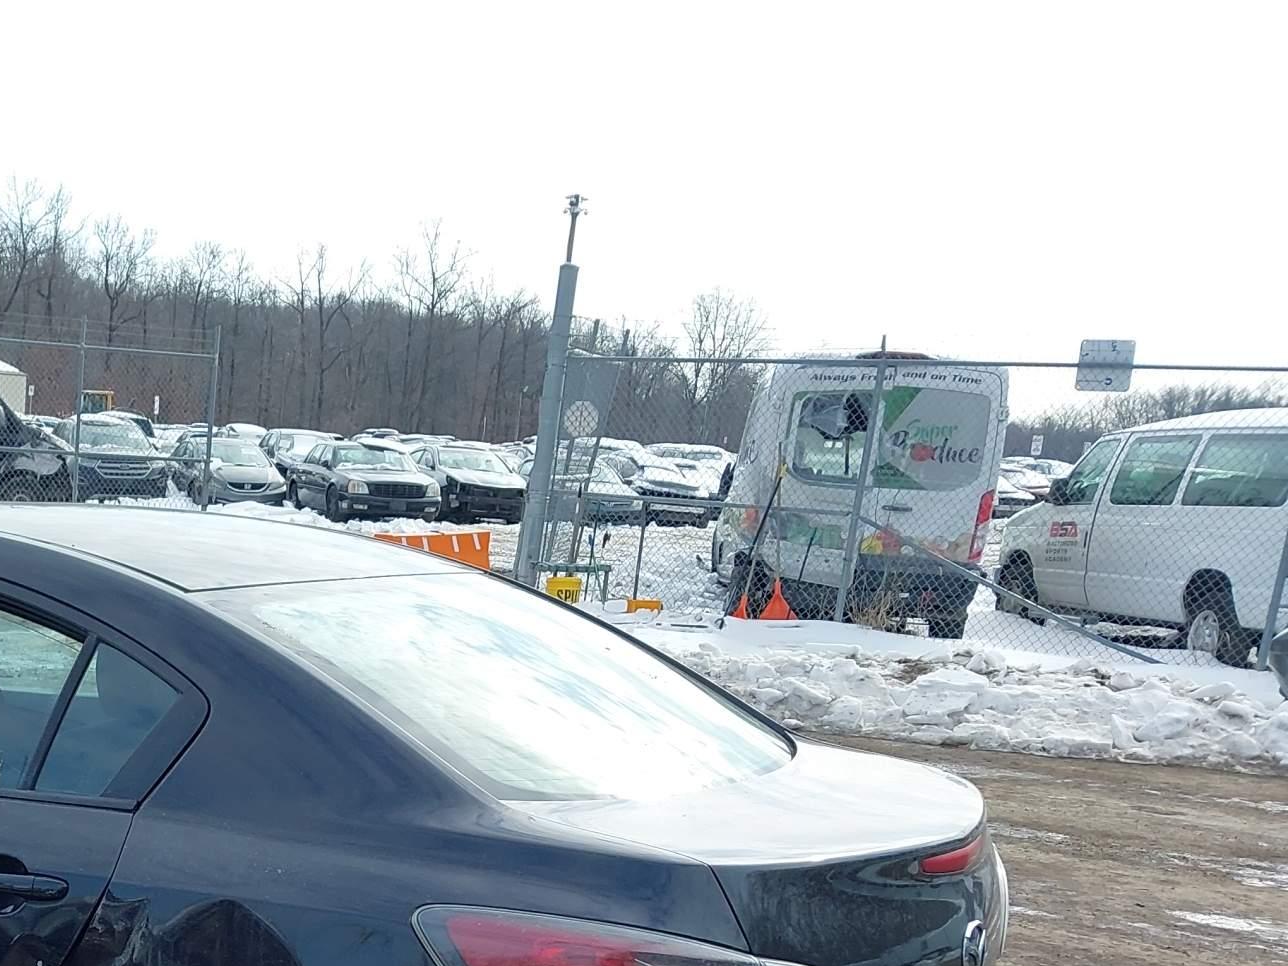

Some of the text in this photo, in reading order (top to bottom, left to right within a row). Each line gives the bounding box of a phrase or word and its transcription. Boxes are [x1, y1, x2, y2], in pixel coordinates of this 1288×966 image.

[810, 373, 856, 383] Always
[902, 371, 926, 380] and
[952, 374, 983, 385] Time
